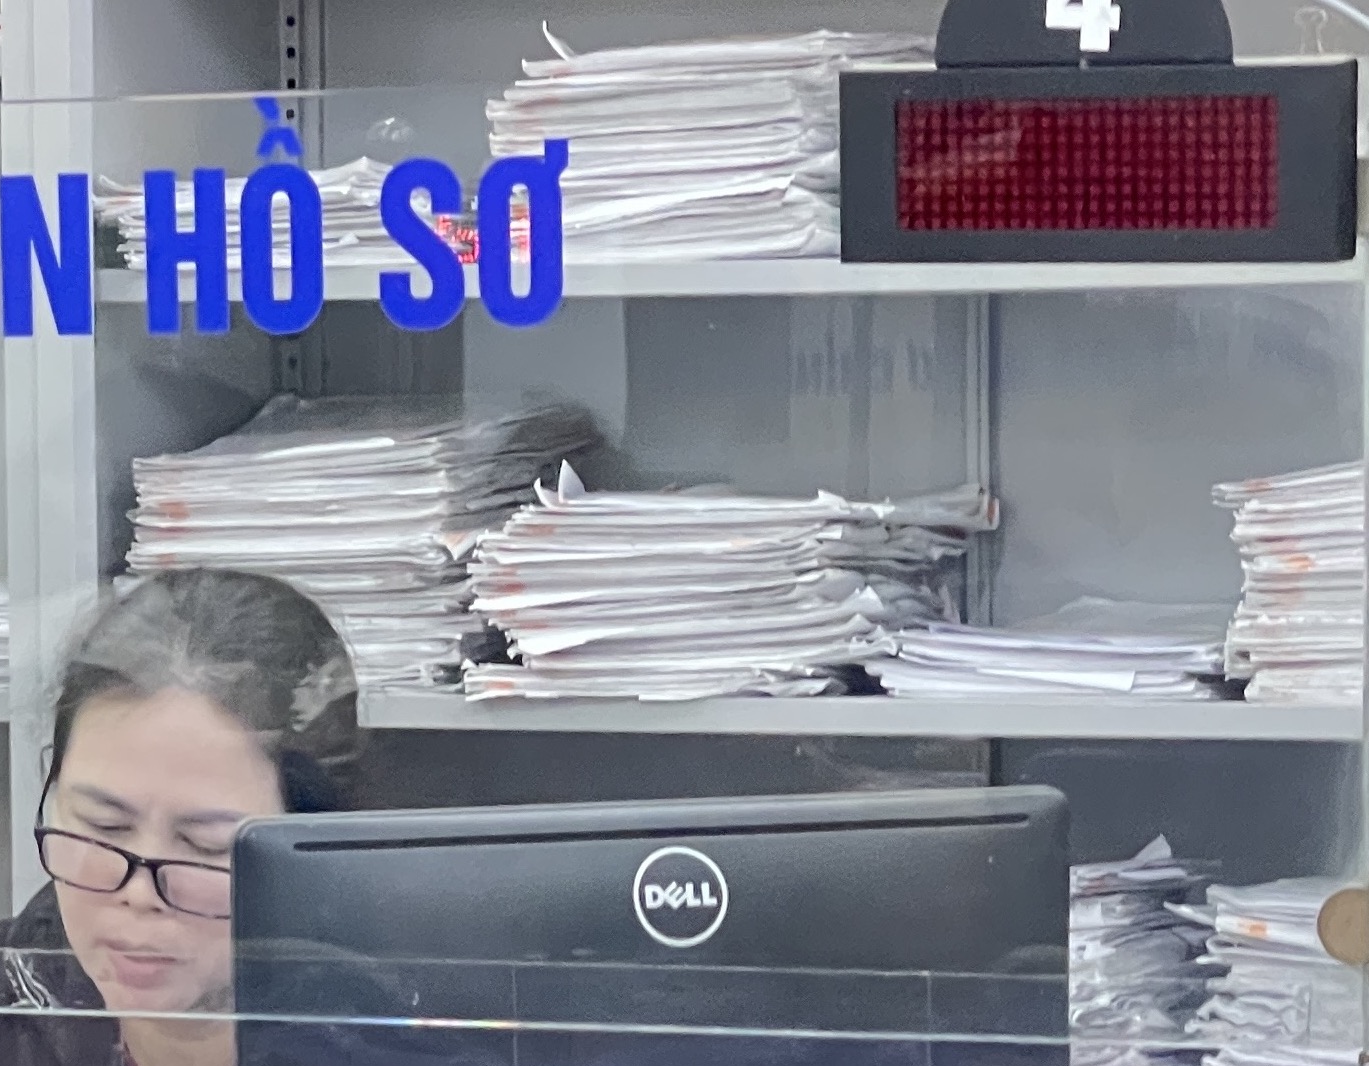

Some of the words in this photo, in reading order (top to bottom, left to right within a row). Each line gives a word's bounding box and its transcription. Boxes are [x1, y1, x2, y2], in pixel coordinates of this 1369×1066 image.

[1045, 0, 1121, 52] 4
[144, 96, 324, 334] HỒ
[380, 138, 569, 330] SƠ
[644, 881, 718, 910] DELL
